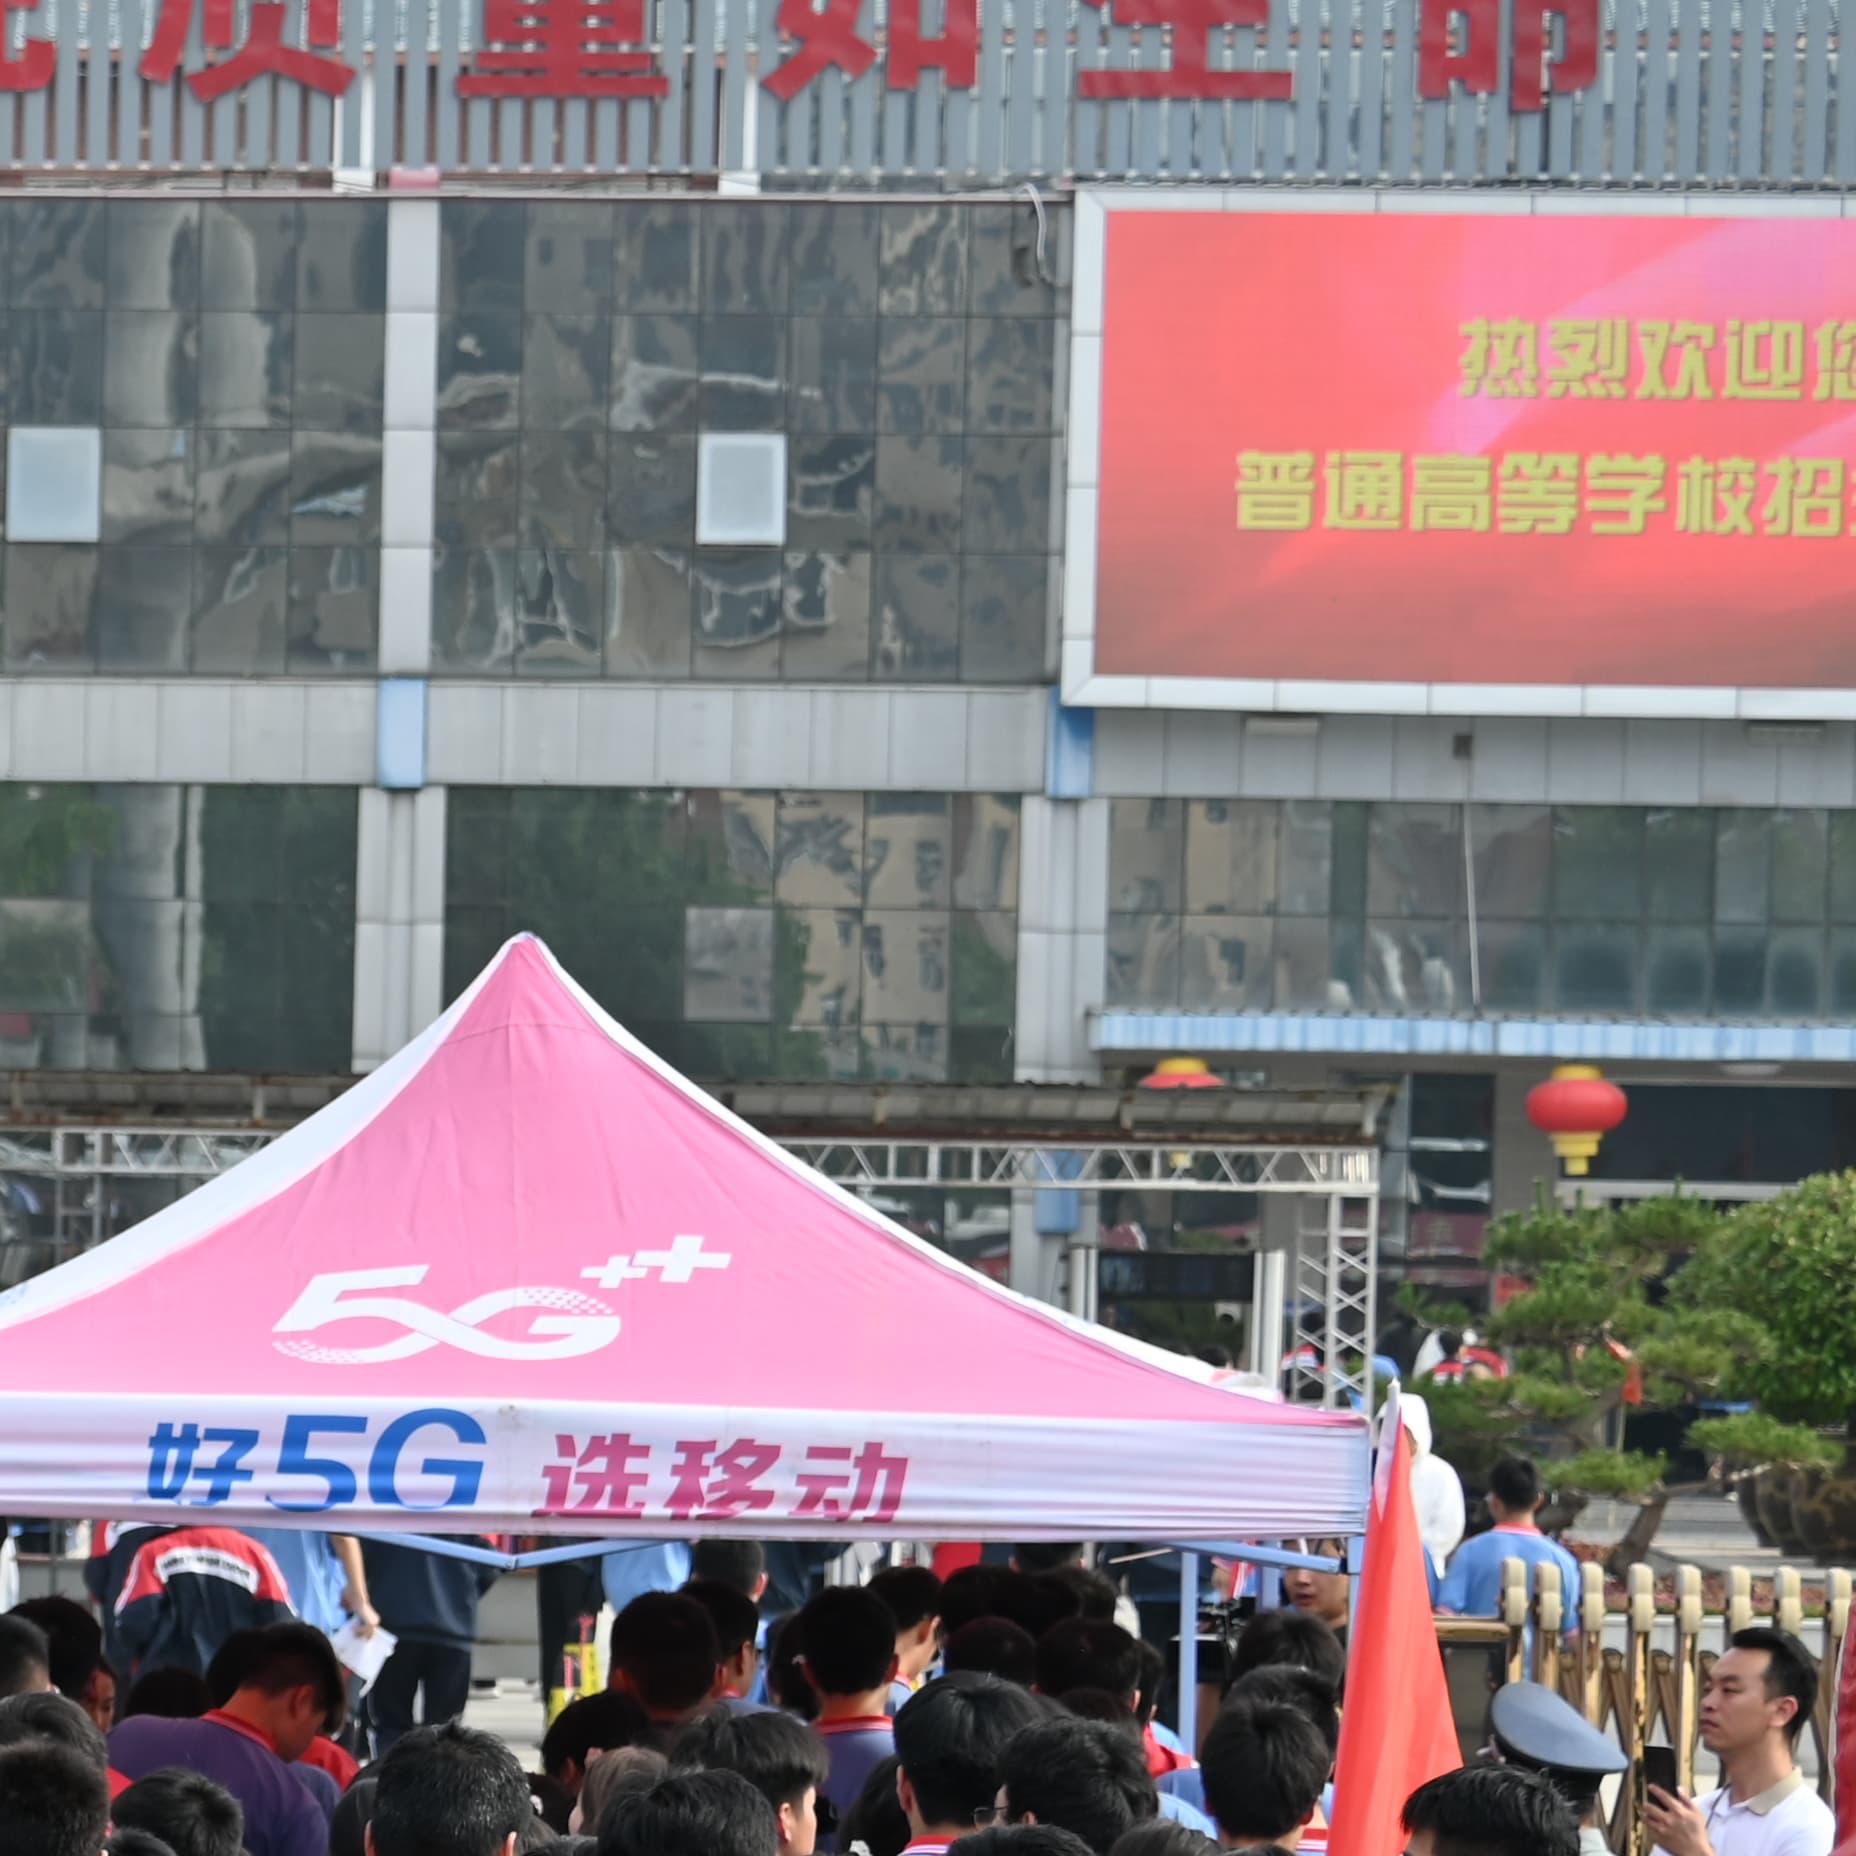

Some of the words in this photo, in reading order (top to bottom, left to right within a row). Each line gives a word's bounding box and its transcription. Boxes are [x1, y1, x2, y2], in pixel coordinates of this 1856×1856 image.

[1235, 450, 1856, 537] 普通高等学校招
[530, 1433, 909, 1523] 选移动
